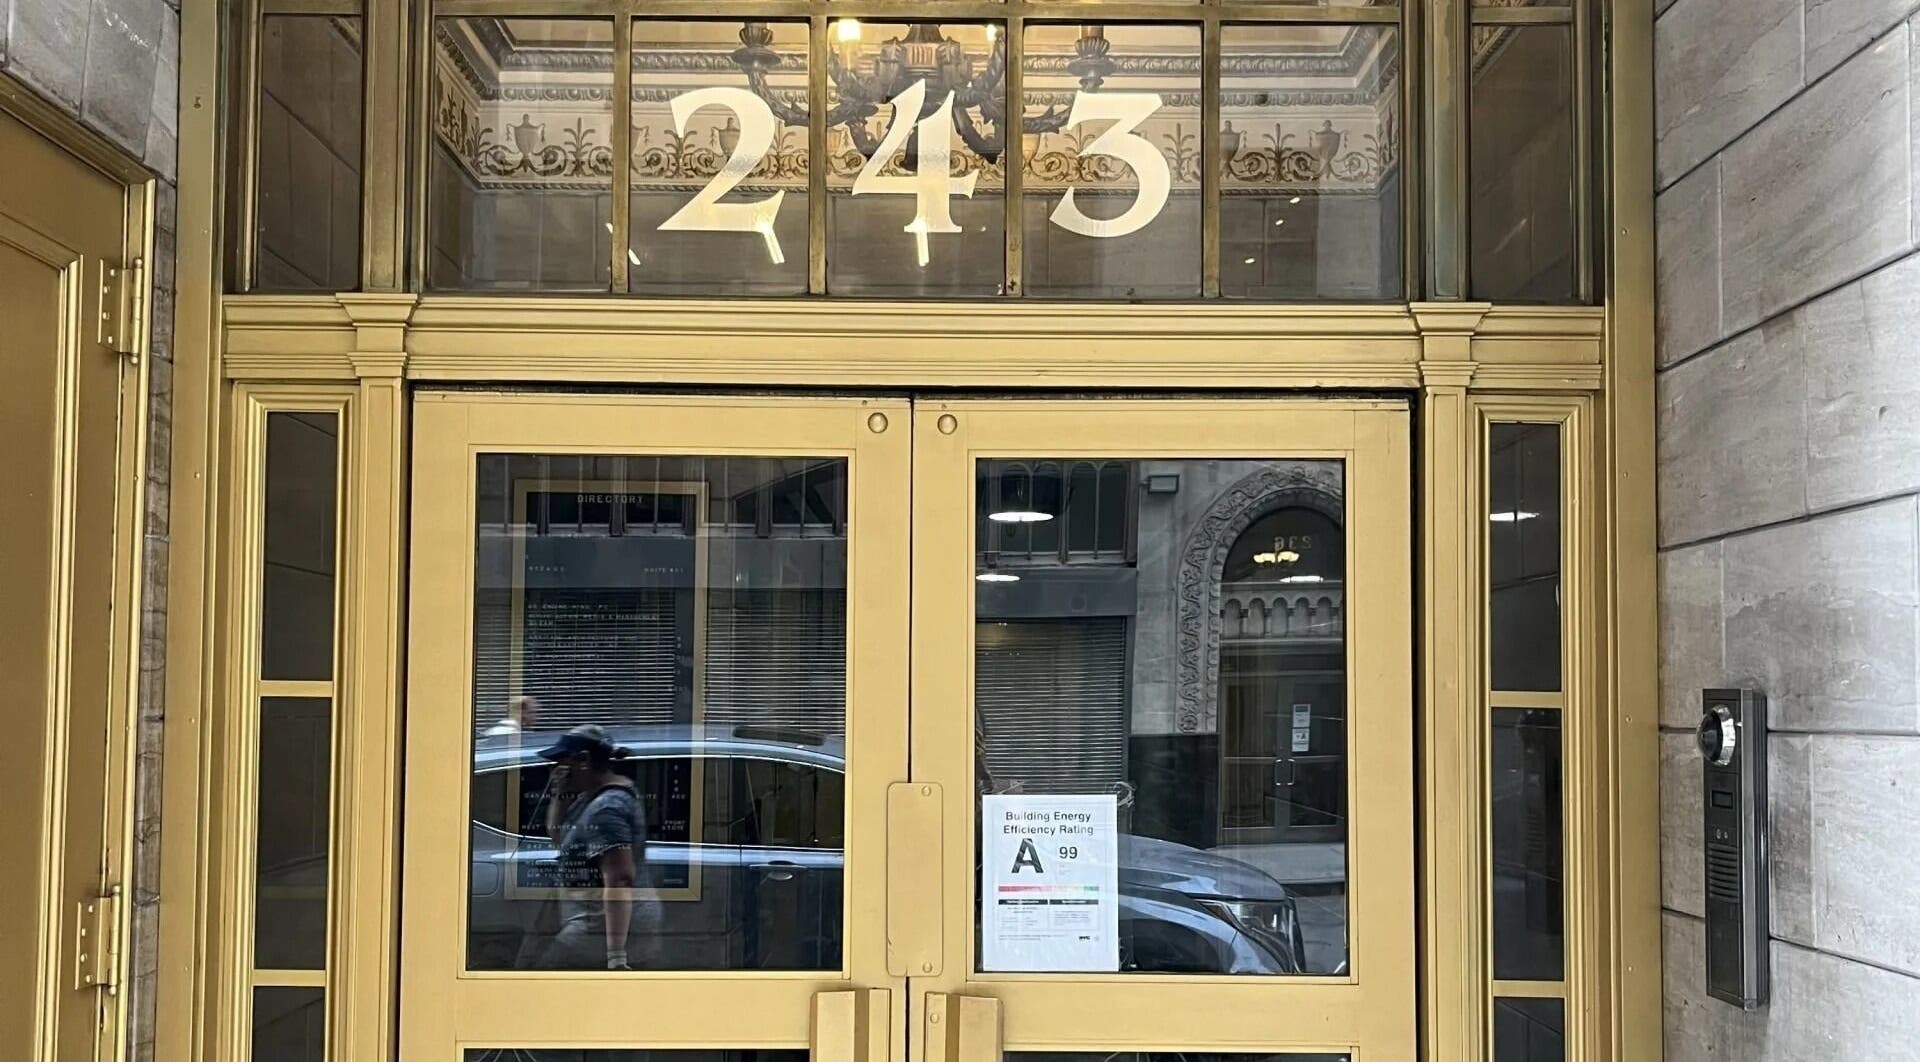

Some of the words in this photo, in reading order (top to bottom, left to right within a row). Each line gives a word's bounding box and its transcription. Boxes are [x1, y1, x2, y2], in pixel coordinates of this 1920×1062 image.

[657, 78, 1171, 237] 243
[577, 494, 644, 504] DIRECTORY
[1005, 811, 1050, 822] Building
[1053, 811, 1091, 822] Energy
[1003, 824, 1056, 836] Efficiency
[1059, 824, 1094, 835] Rating
[1011, 838, 1044, 873] A
[1059, 846, 1078, 859] 99
